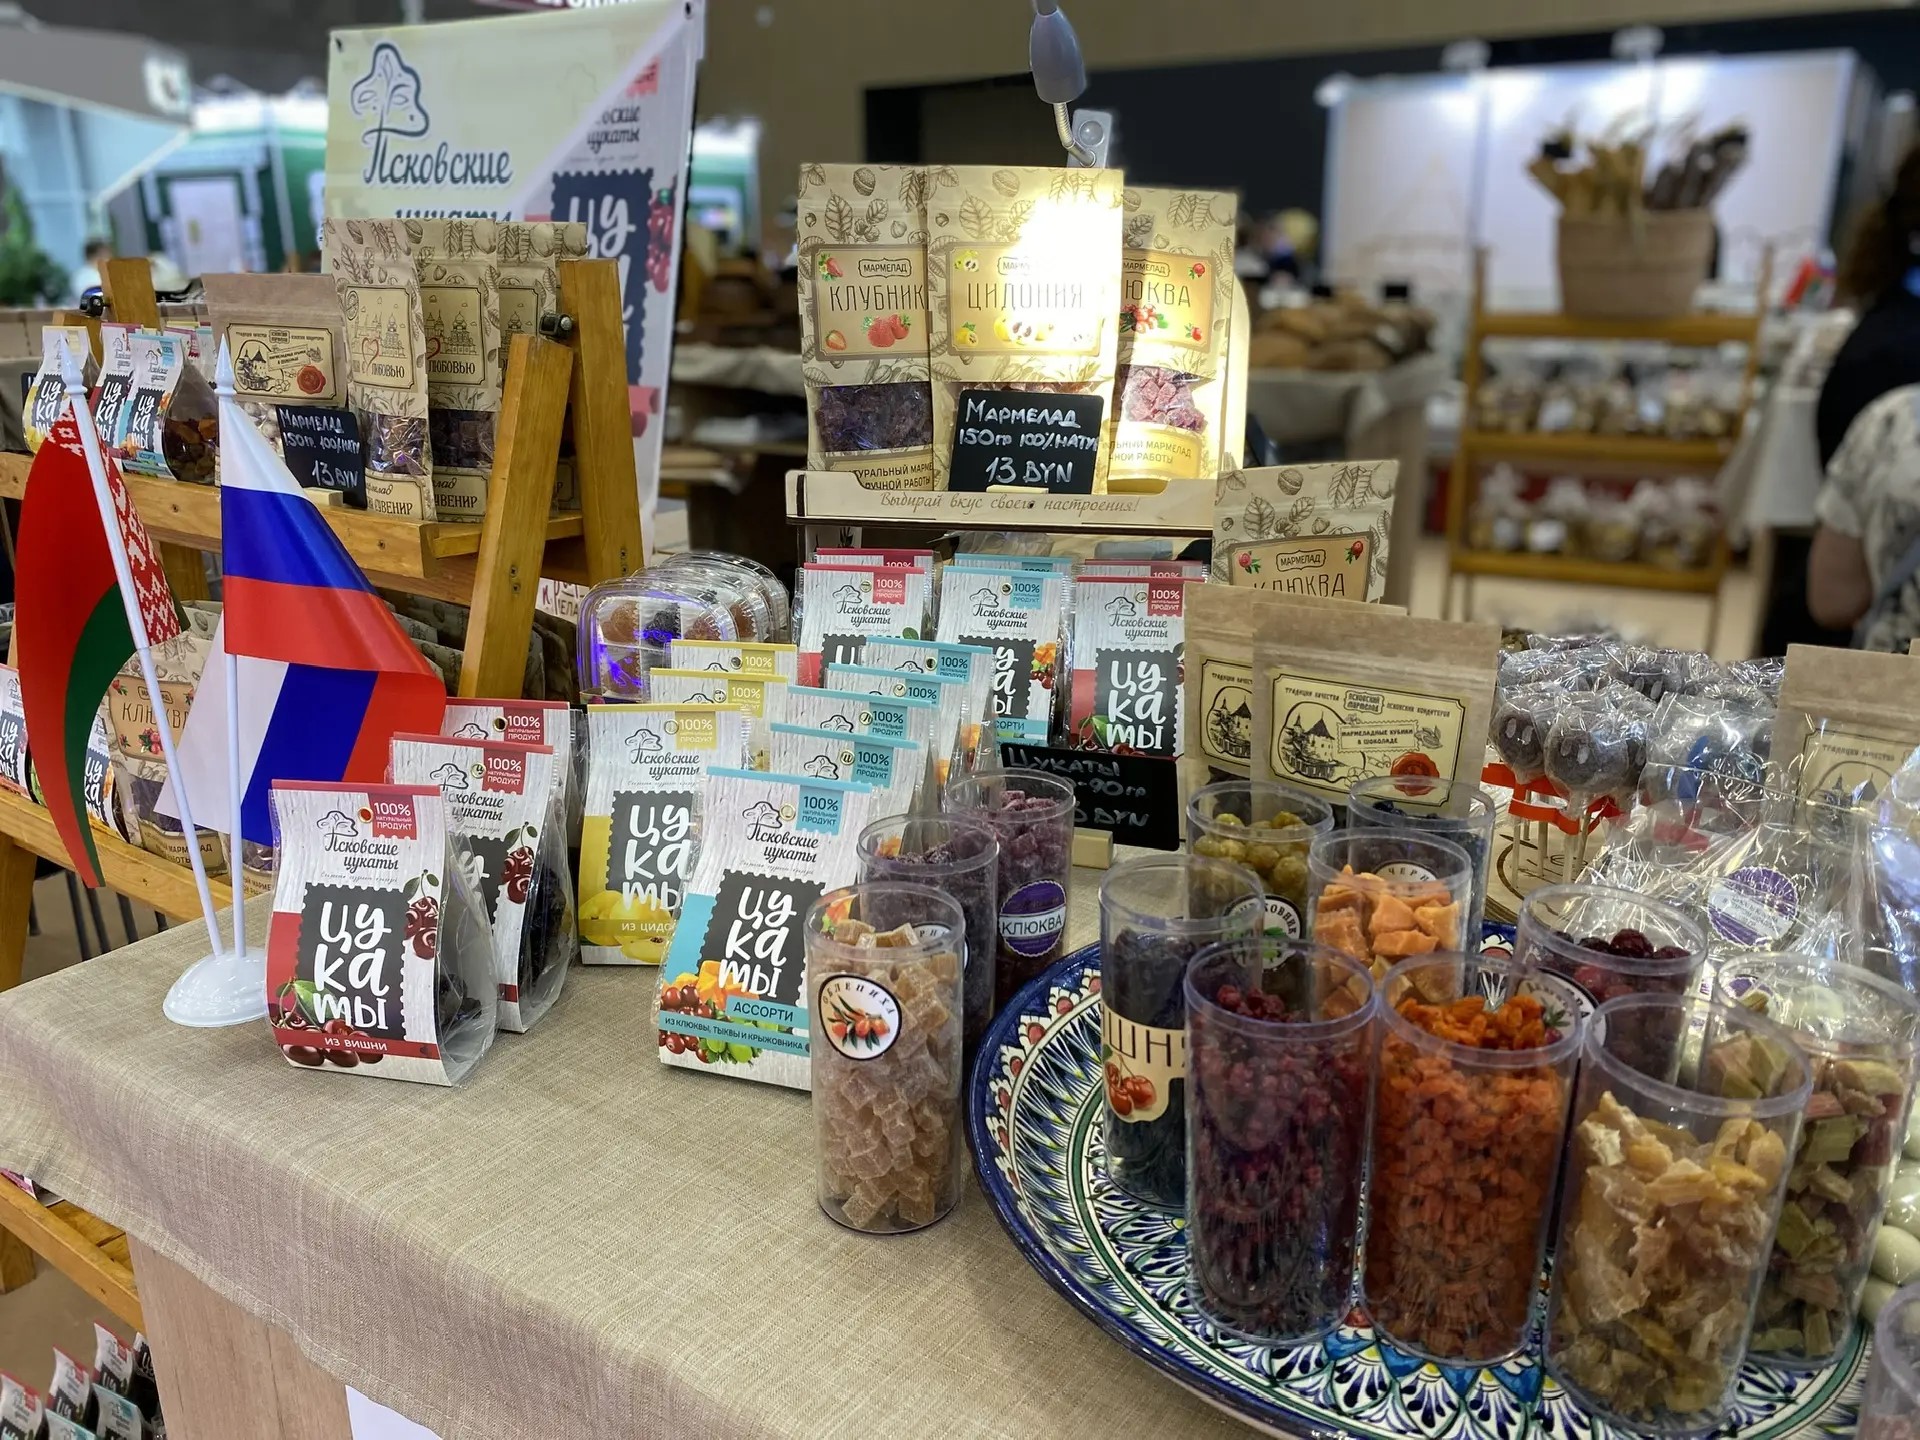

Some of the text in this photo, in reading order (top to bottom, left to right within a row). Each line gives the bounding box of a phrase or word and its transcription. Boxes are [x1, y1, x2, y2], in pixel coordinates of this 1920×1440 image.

[362, 131, 513, 185] Псковские
[862, 262, 909, 274] МАРМЕЛАД
[1122, 260, 1167, 275] МАРМЕЛАД
[967, 282, 1083, 311] ЦИДОНИЯ
[964, 398, 1082, 429] МАРМЕЛАД
[1145, 440, 1192, 458] МАРМЕЛАД
[1136, 453, 1174, 464] РАБОТЫ
[312, 459, 359, 488] 13 BYN
[985, 456, 1074, 484] 13 BYN
[903, 476, 931, 489] РАБОТЫ
[880, 491, 942, 513] Выбирай
[951, 494, 983, 515] вкус
[1043, 499, 1140, 517] настроения!
[1279, 554, 1321, 566] МАРМЕЛАД
[876, 579, 903, 589] 100%
[1014, 583, 1040, 594] 100%
[1151, 589, 1180, 600] 100%
[836, 601, 891, 616] Псковские
[972, 604, 1028, 620] Псковские
[850, 615, 891, 628] цукаты
[986, 619, 1028, 631] цукаты
[1109, 614, 1168, 629] Псковские
[1124, 628, 1168, 641] цукаты
[744, 656, 772, 668] 100%
[940, 656, 968, 669] 100%
[1110, 660, 1167, 697] цу
[731, 686, 761, 699] 100%
[907, 686, 937, 700] 100%
[1107, 689, 1167, 725] ка
[507, 715, 541, 728] 100%
[680, 718, 713, 731] 100%
[872, 710, 904, 724] 100%
[507, 733, 541, 741] ПРОДУКТ
[872, 727, 903, 737] ПРОДУКТ
[1106, 722, 1164, 750] ты
[1363, 737, 1398, 745] ШОКОЛАДЕ
[487, 757, 522, 772] 100%
[630, 749, 700, 765] Псковские
[858, 751, 890, 766] 100%
[1008, 747, 1121, 777] ЦУКАТЫ
[487, 776, 521, 785] ПРОДУКТ
[648, 766, 700, 781] цукаты
[856, 768, 888, 780] ПРОДУКТ
[373, 802, 412, 816] 100%
[803, 795, 839, 812] 100%
[376, 821, 413, 830] ПРОДУКТ
[628, 803, 697, 846] цу
[801, 815, 836, 826] ПРОДУКТ
[746, 823, 819, 849] Псковские
[324, 833, 399, 856] Псковские
[624, 838, 691, 881] ка
[763, 845, 817, 864] цукаты
[343, 855, 399, 874] цукаты
[737, 885, 797, 930] цу
[319, 901, 392, 954] цу
[621, 922, 636, 932] ИЗ
[1001, 916, 1062, 936] КЛЮКВА
[725, 919, 790, 966] ка
[313, 943, 390, 997] ка
[717, 958, 783, 998] ты
[822, 982, 896, 1016] ОБЛЕПИХА
[312, 992, 389, 1030] ты
[733, 1001, 794, 1022] АССОРТИ
[665, 1017, 804, 1050] ИЗ КЛЮКВЫ, ТЫКВЫ И КРЫЖОВНИКА
[324, 1037, 388, 1051] ИЗ ВИШНИ
